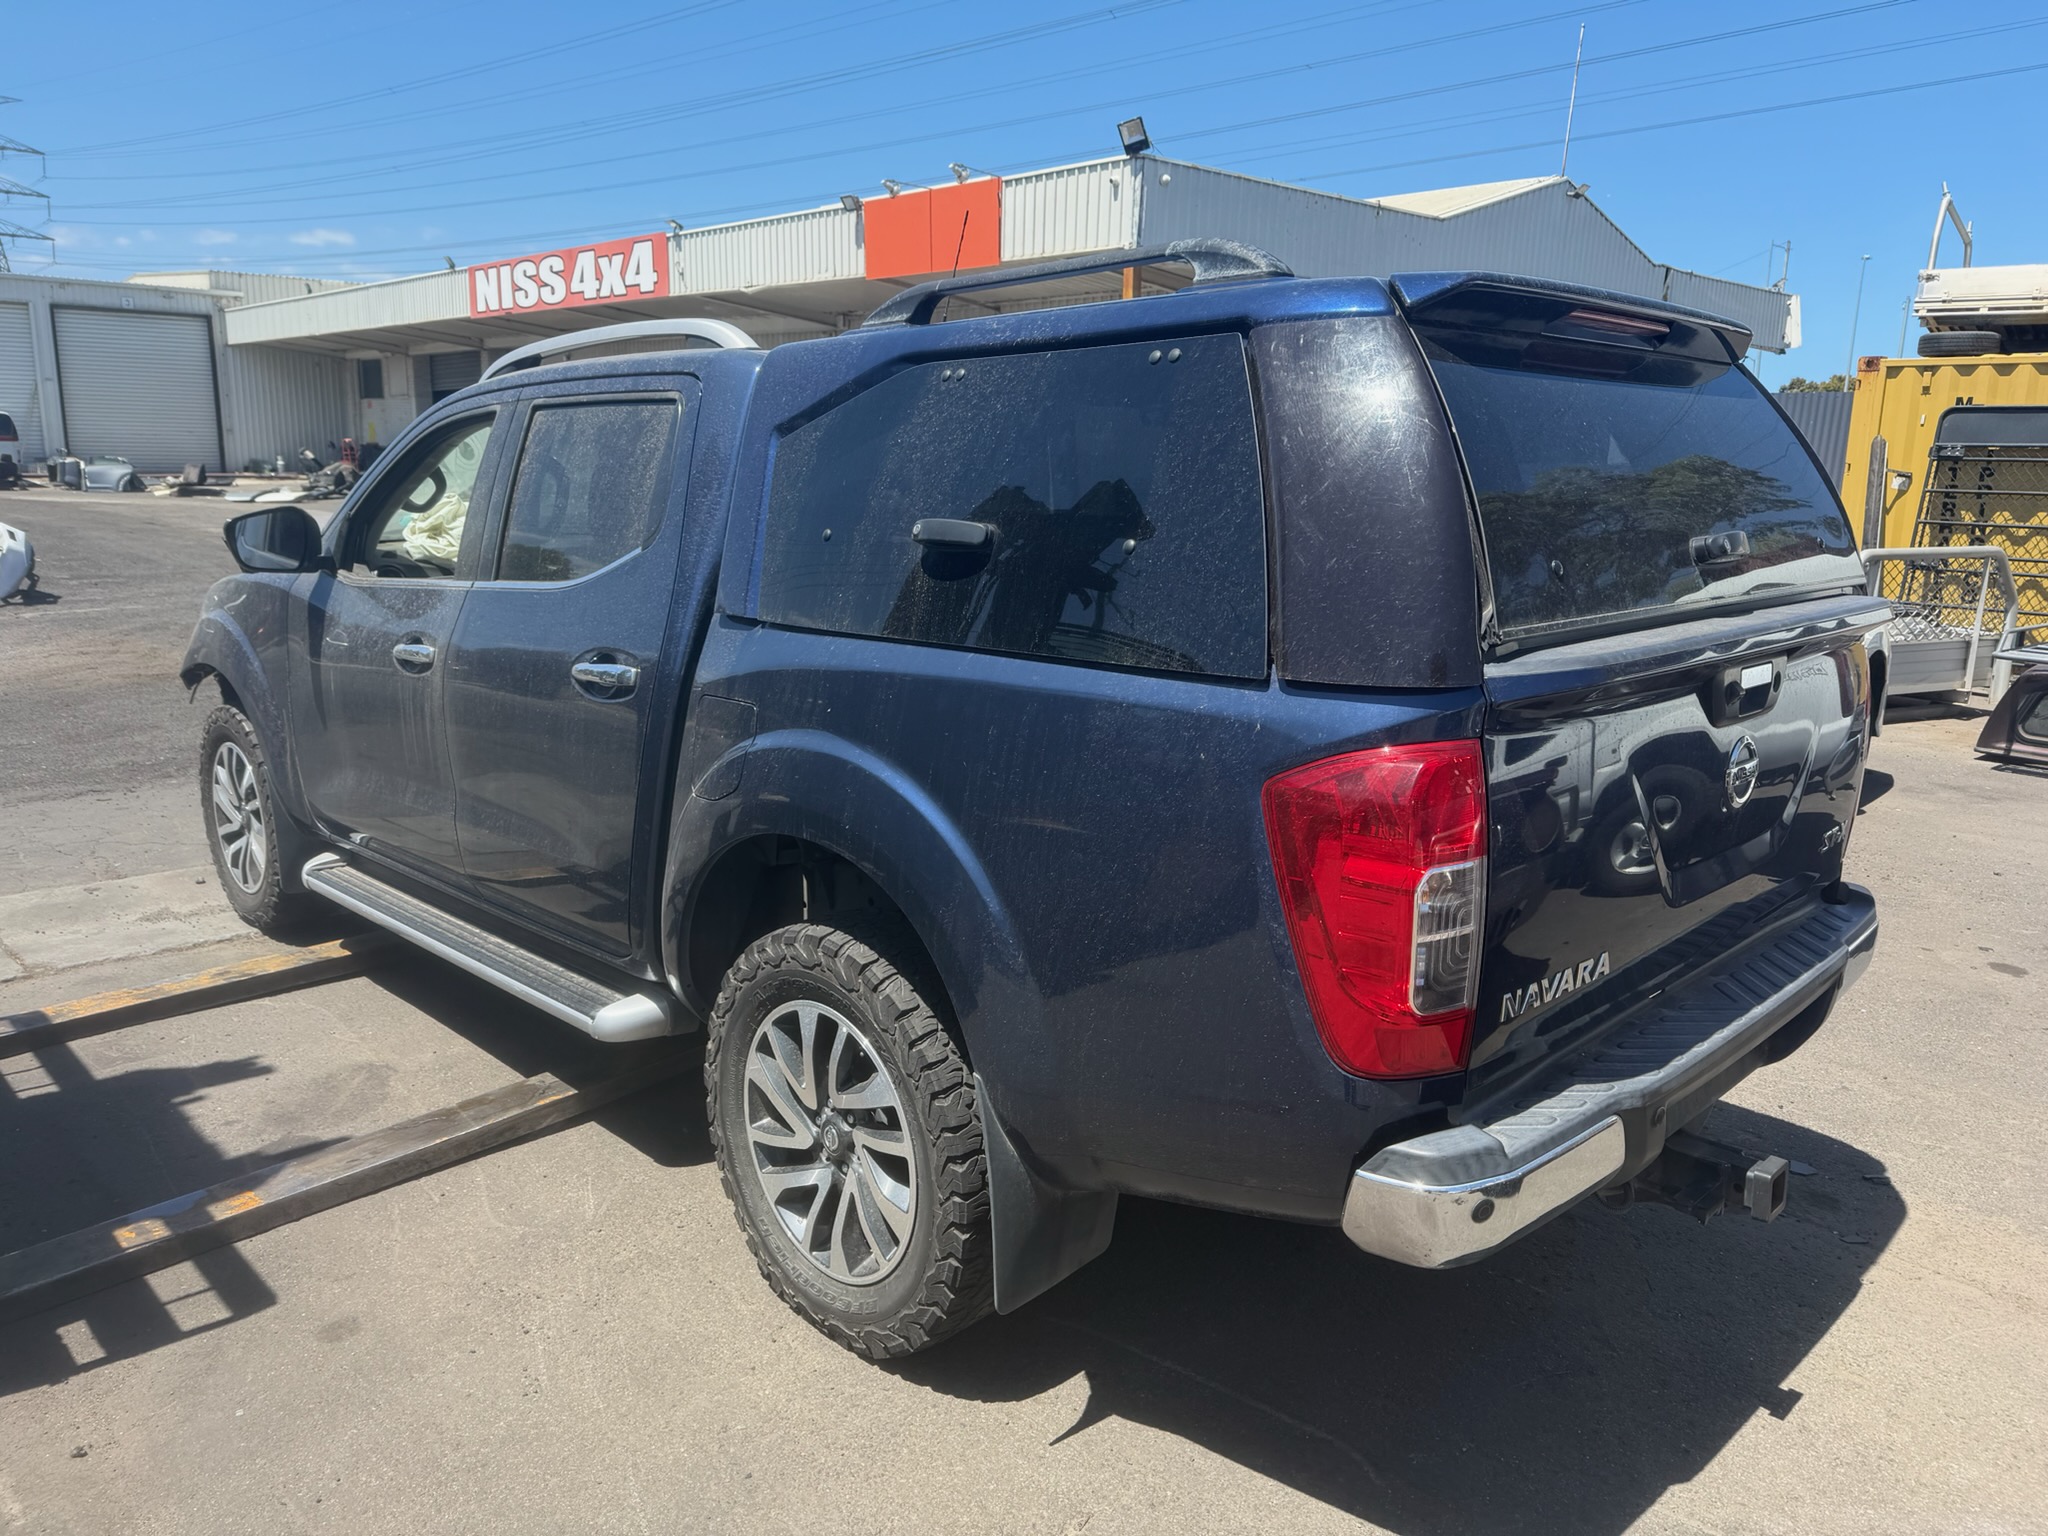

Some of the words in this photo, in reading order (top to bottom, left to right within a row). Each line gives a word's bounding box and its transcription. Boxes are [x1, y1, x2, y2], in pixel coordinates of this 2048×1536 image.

[475, 255, 567, 313] NISS
[569, 239, 658, 300] 4x4
[1500, 951, 1611, 1023] NAVARA
